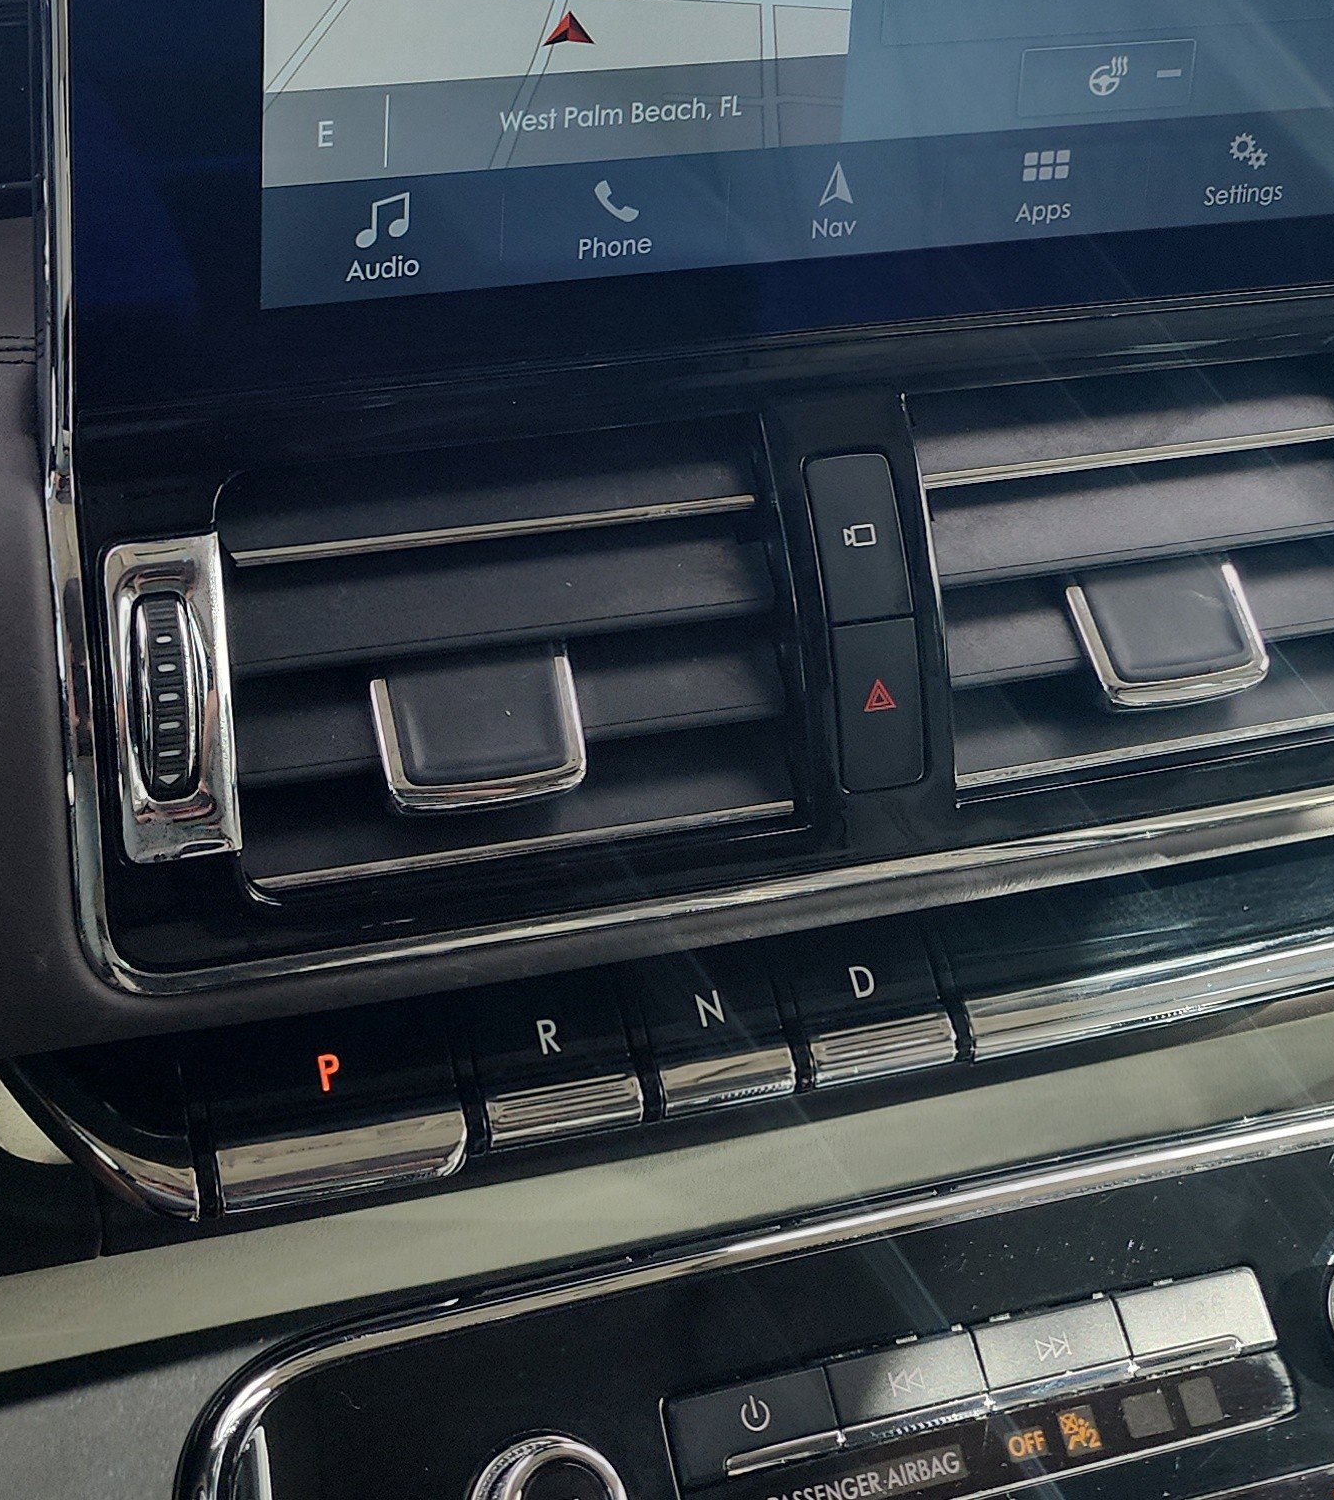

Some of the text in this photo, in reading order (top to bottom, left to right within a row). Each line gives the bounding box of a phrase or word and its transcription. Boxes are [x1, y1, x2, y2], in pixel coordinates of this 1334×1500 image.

[499, 94, 743, 134] West Palm Beach, FL
[317, 120, 334, 149] E
[1202, 181, 1284, 210] Settings
[1015, 199, 1072, 227] Apps
[811, 217, 858, 241] Nav
[577, 235, 653, 261] Phone
[345, 256, 420, 283] Audio
[848, 965, 877, 1000] D
[695, 989, 727, 1028] N
[536, 1018, 560, 1055] R
[317, 1053, 341, 1093] P
[1008, 1430, 1046, 1458] OFF
[886, 1451, 960, 1491] AIRBAG
